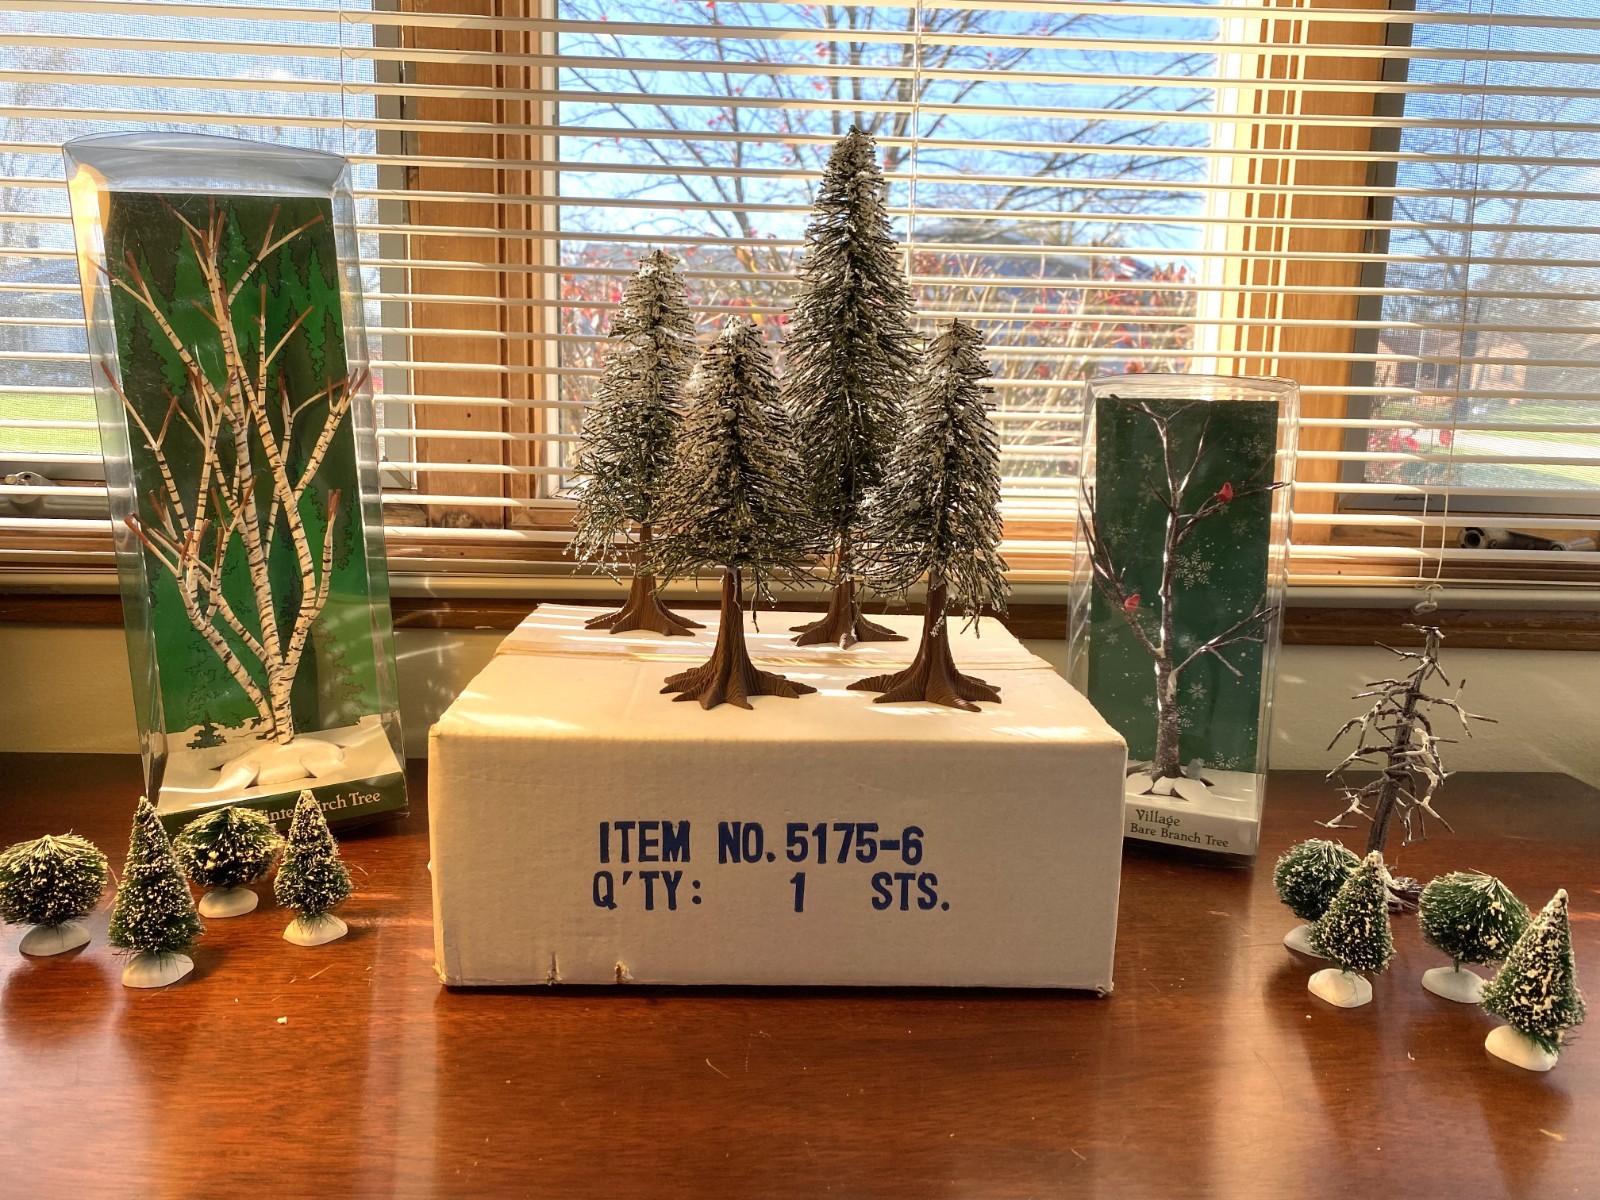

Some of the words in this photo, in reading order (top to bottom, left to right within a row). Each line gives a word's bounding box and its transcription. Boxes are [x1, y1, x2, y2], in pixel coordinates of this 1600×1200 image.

[317, 795, 348, 811] irch
[349, 792, 380, 806] Tree
[1135, 808, 1180, 828] Village
[600, 821, 691, 863] ITEM
[1130, 823, 1157, 836] Bare
[1161, 827, 1201, 844] Branch
[1205, 835, 1229, 848] Tree
[592, 870, 702, 910] Q'TY:
[790, 872, 806, 912] 1
[871, 872, 950, 911] STS.
